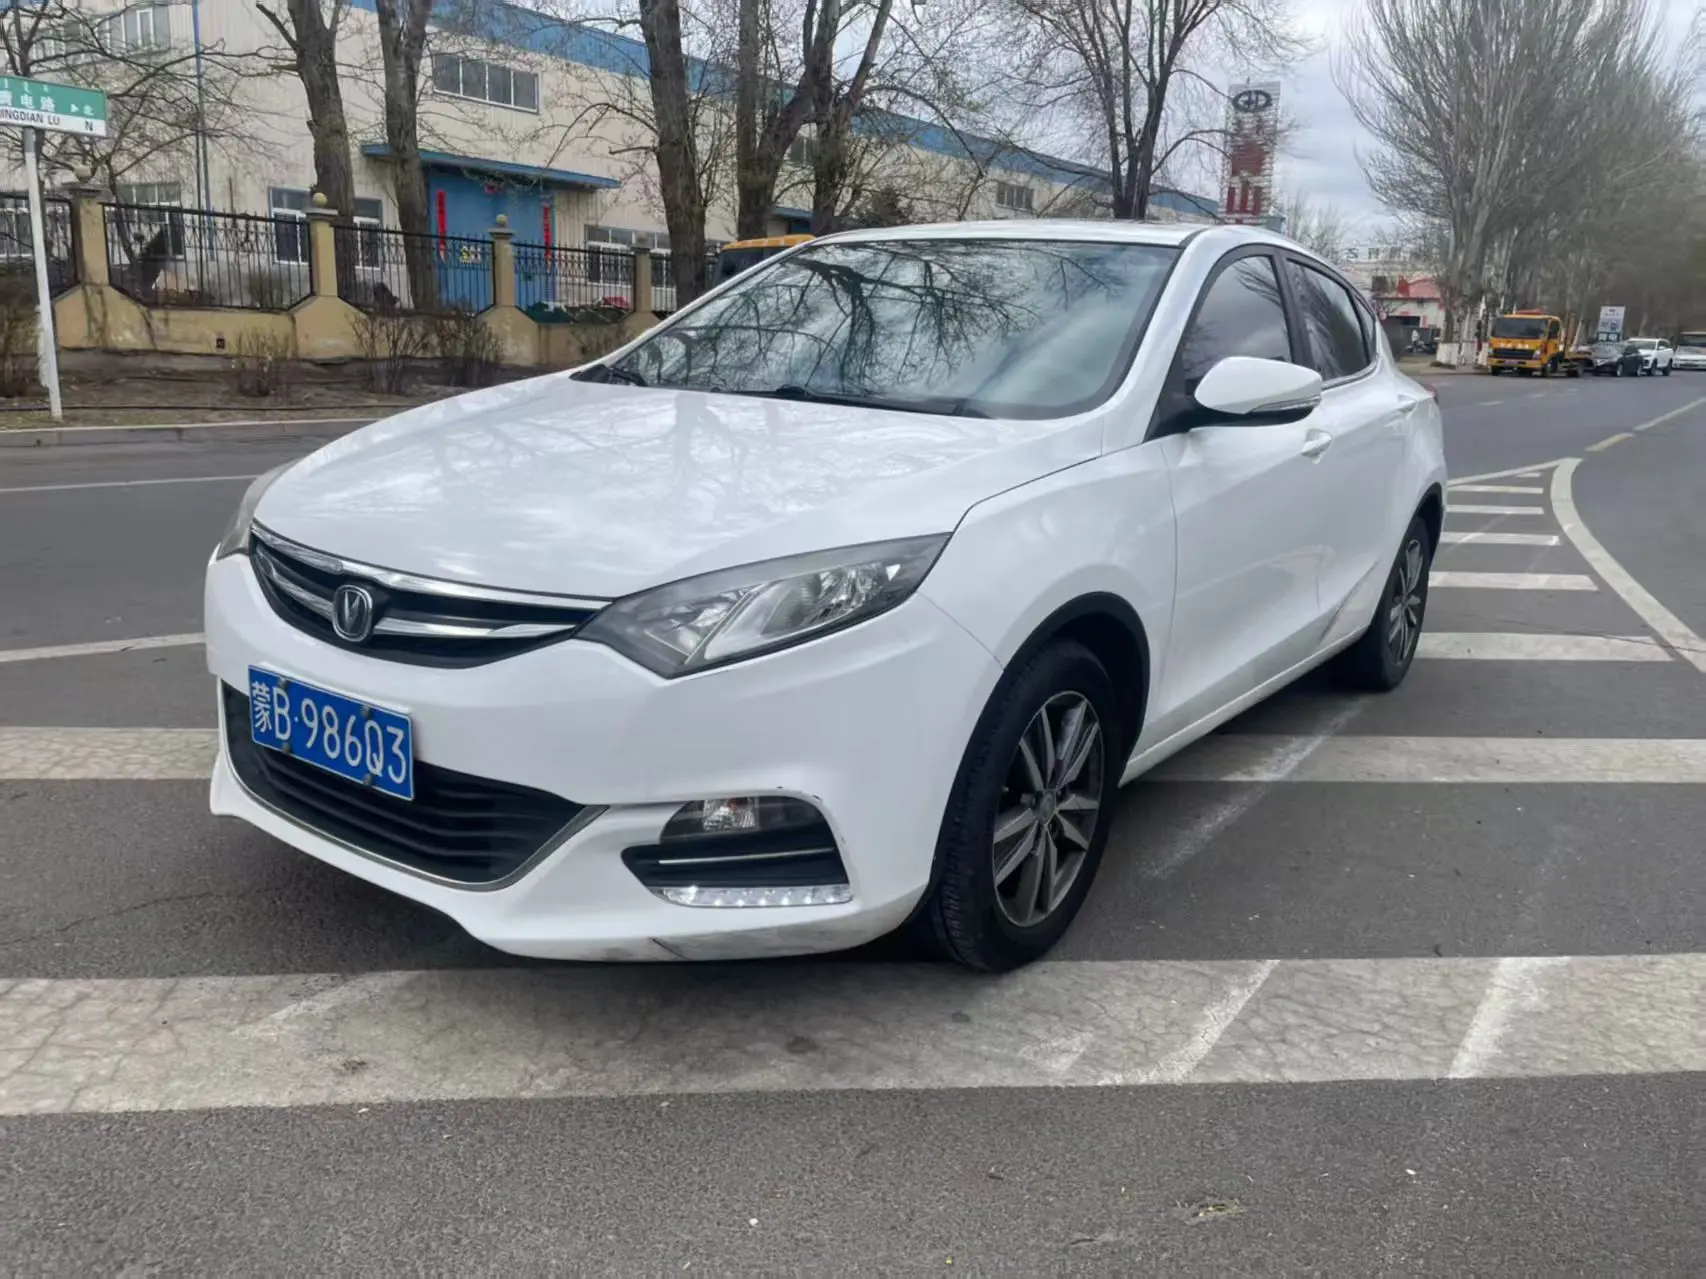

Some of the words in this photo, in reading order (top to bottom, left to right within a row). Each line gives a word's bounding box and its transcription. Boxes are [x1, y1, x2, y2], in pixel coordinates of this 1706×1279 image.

[0, 108, 44, 124] INGDIAN
[47, 115, 60, 126] LU
[84, 119, 93, 132] N
[252, 681, 407, 784] 蒙B·986Q3
